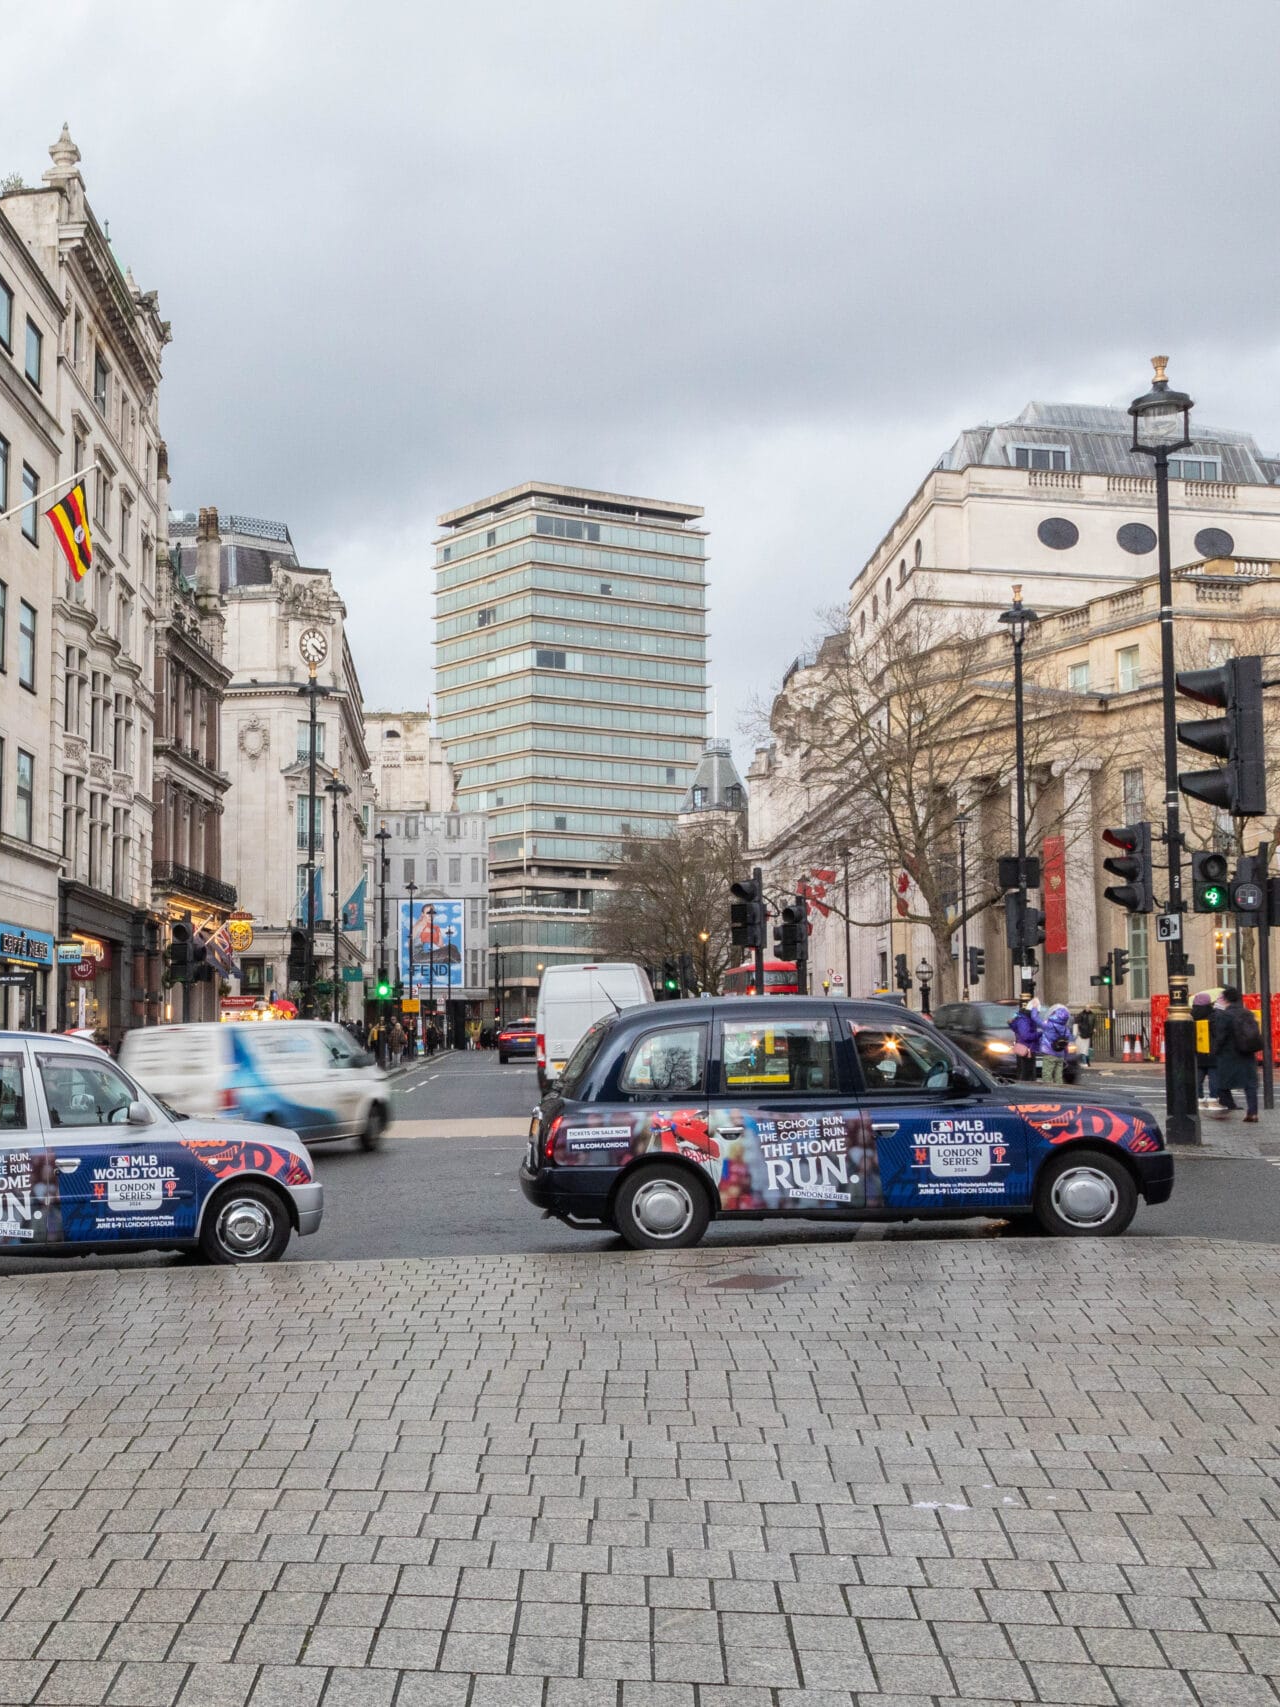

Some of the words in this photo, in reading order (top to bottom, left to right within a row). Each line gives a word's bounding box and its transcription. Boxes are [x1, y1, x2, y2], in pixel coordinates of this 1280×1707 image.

[28, 939, 49, 959] NERO
[411, 963, 450, 977] FEND
[756, 1122, 776, 1132] THE
[777, 1118, 821, 1130] SCHOOL
[822, 1116, 845, 1126] RUN.
[954, 1120, 984, 1132] MLB
[758, 1132, 778, 1142] THE
[779, 1128, 821, 1141] COFFEE
[823, 1126, 848, 1136] RUN.
[913, 1133, 965, 1144] WORLD
[966, 1132, 1004, 1143] TOUR
[571, 1141, 629, 1150] MLB.COM/LONDON
[760, 1141, 794, 1158] THE
[796, 1138, 847, 1155] HOME
[9, 1152, 32, 1162] RUN.
[937, 1148, 982, 1158] LONDON
[131, 1155, 158, 1167] MLB
[942, 1157, 979, 1166] SERIES
[9, 1163, 33, 1173] RUN.
[93, 1168, 140, 1180] WORLD
[141, 1166, 175, 1178] TOUR
[765, 1153, 860, 1191] RUN.
[114, 1183, 156, 1192] LONDON
[119, 1191, 152, 1201] SERIES
[791, 1190, 822, 1199] LONDON
